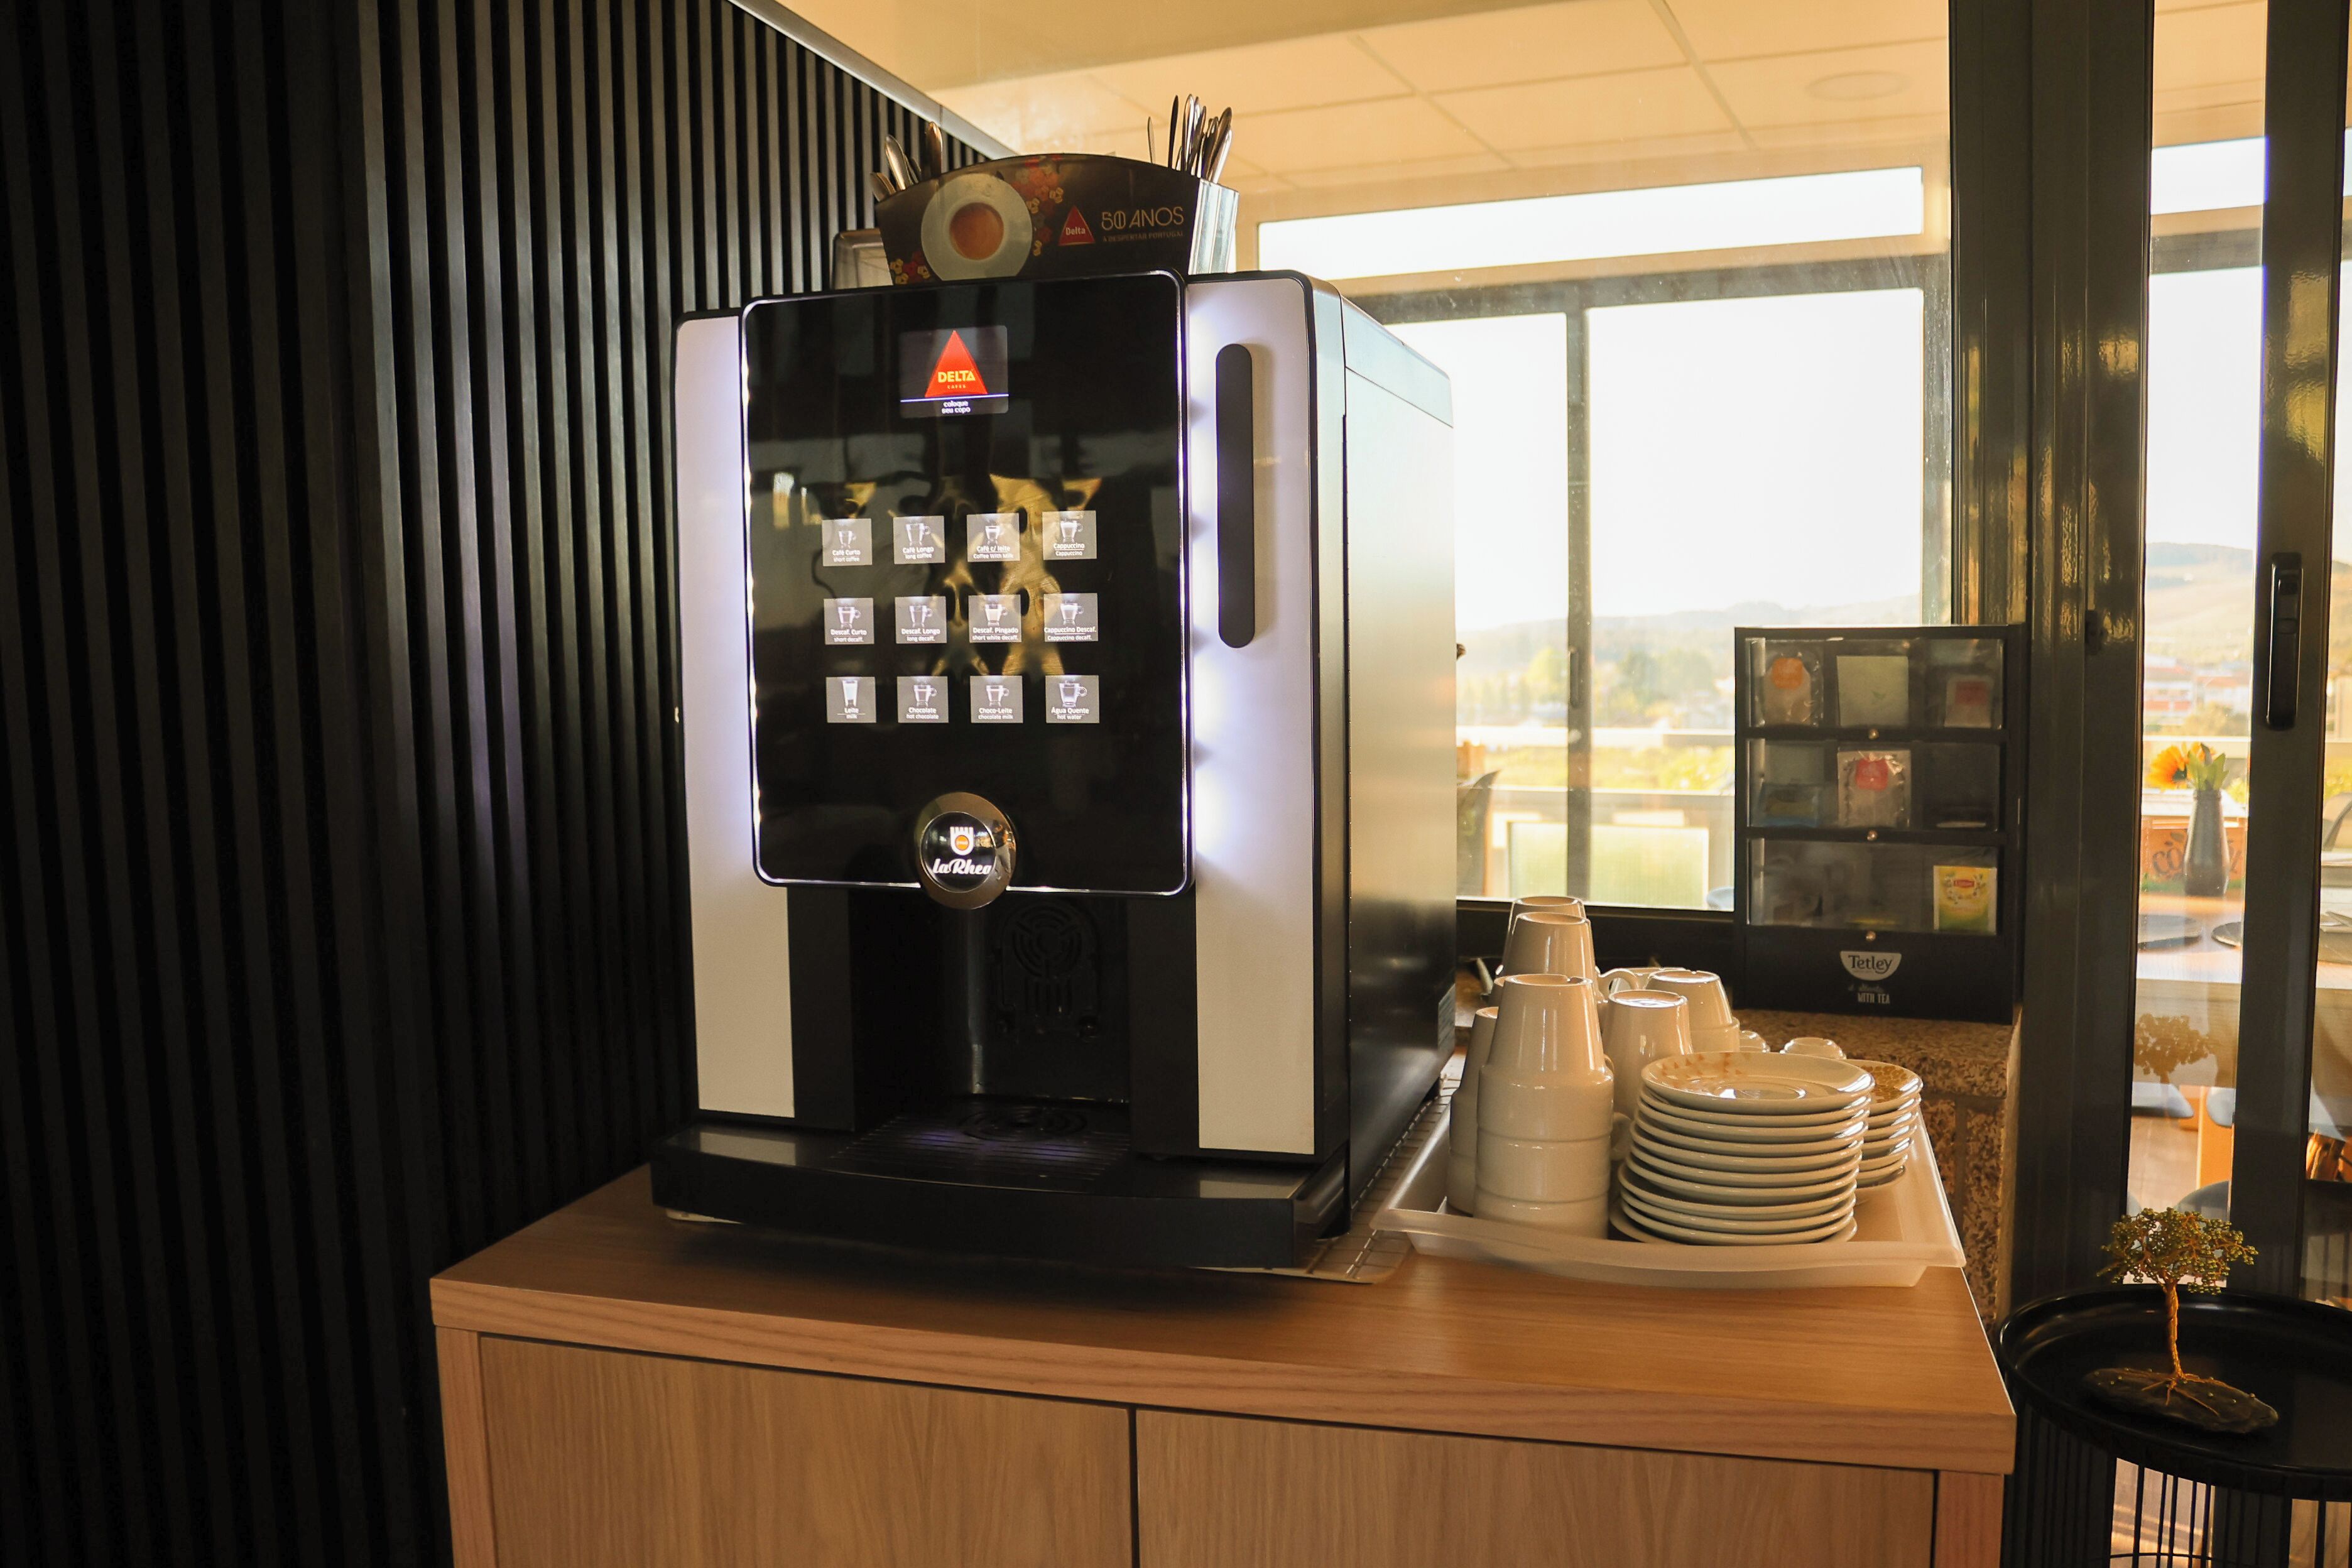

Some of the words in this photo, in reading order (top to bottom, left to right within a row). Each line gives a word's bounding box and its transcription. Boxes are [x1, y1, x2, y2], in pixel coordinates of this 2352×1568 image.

[1101, 210, 1126, 231] 50
[1129, 206, 1185, 229] ANOS
[1065, 226, 1086, 236] Delta
[938, 370, 976, 383] DELTA
[1848, 954, 1893, 974] Tetley
[1858, 992, 1875, 1003] WITH
[1877, 993, 1890, 1004] TEA
